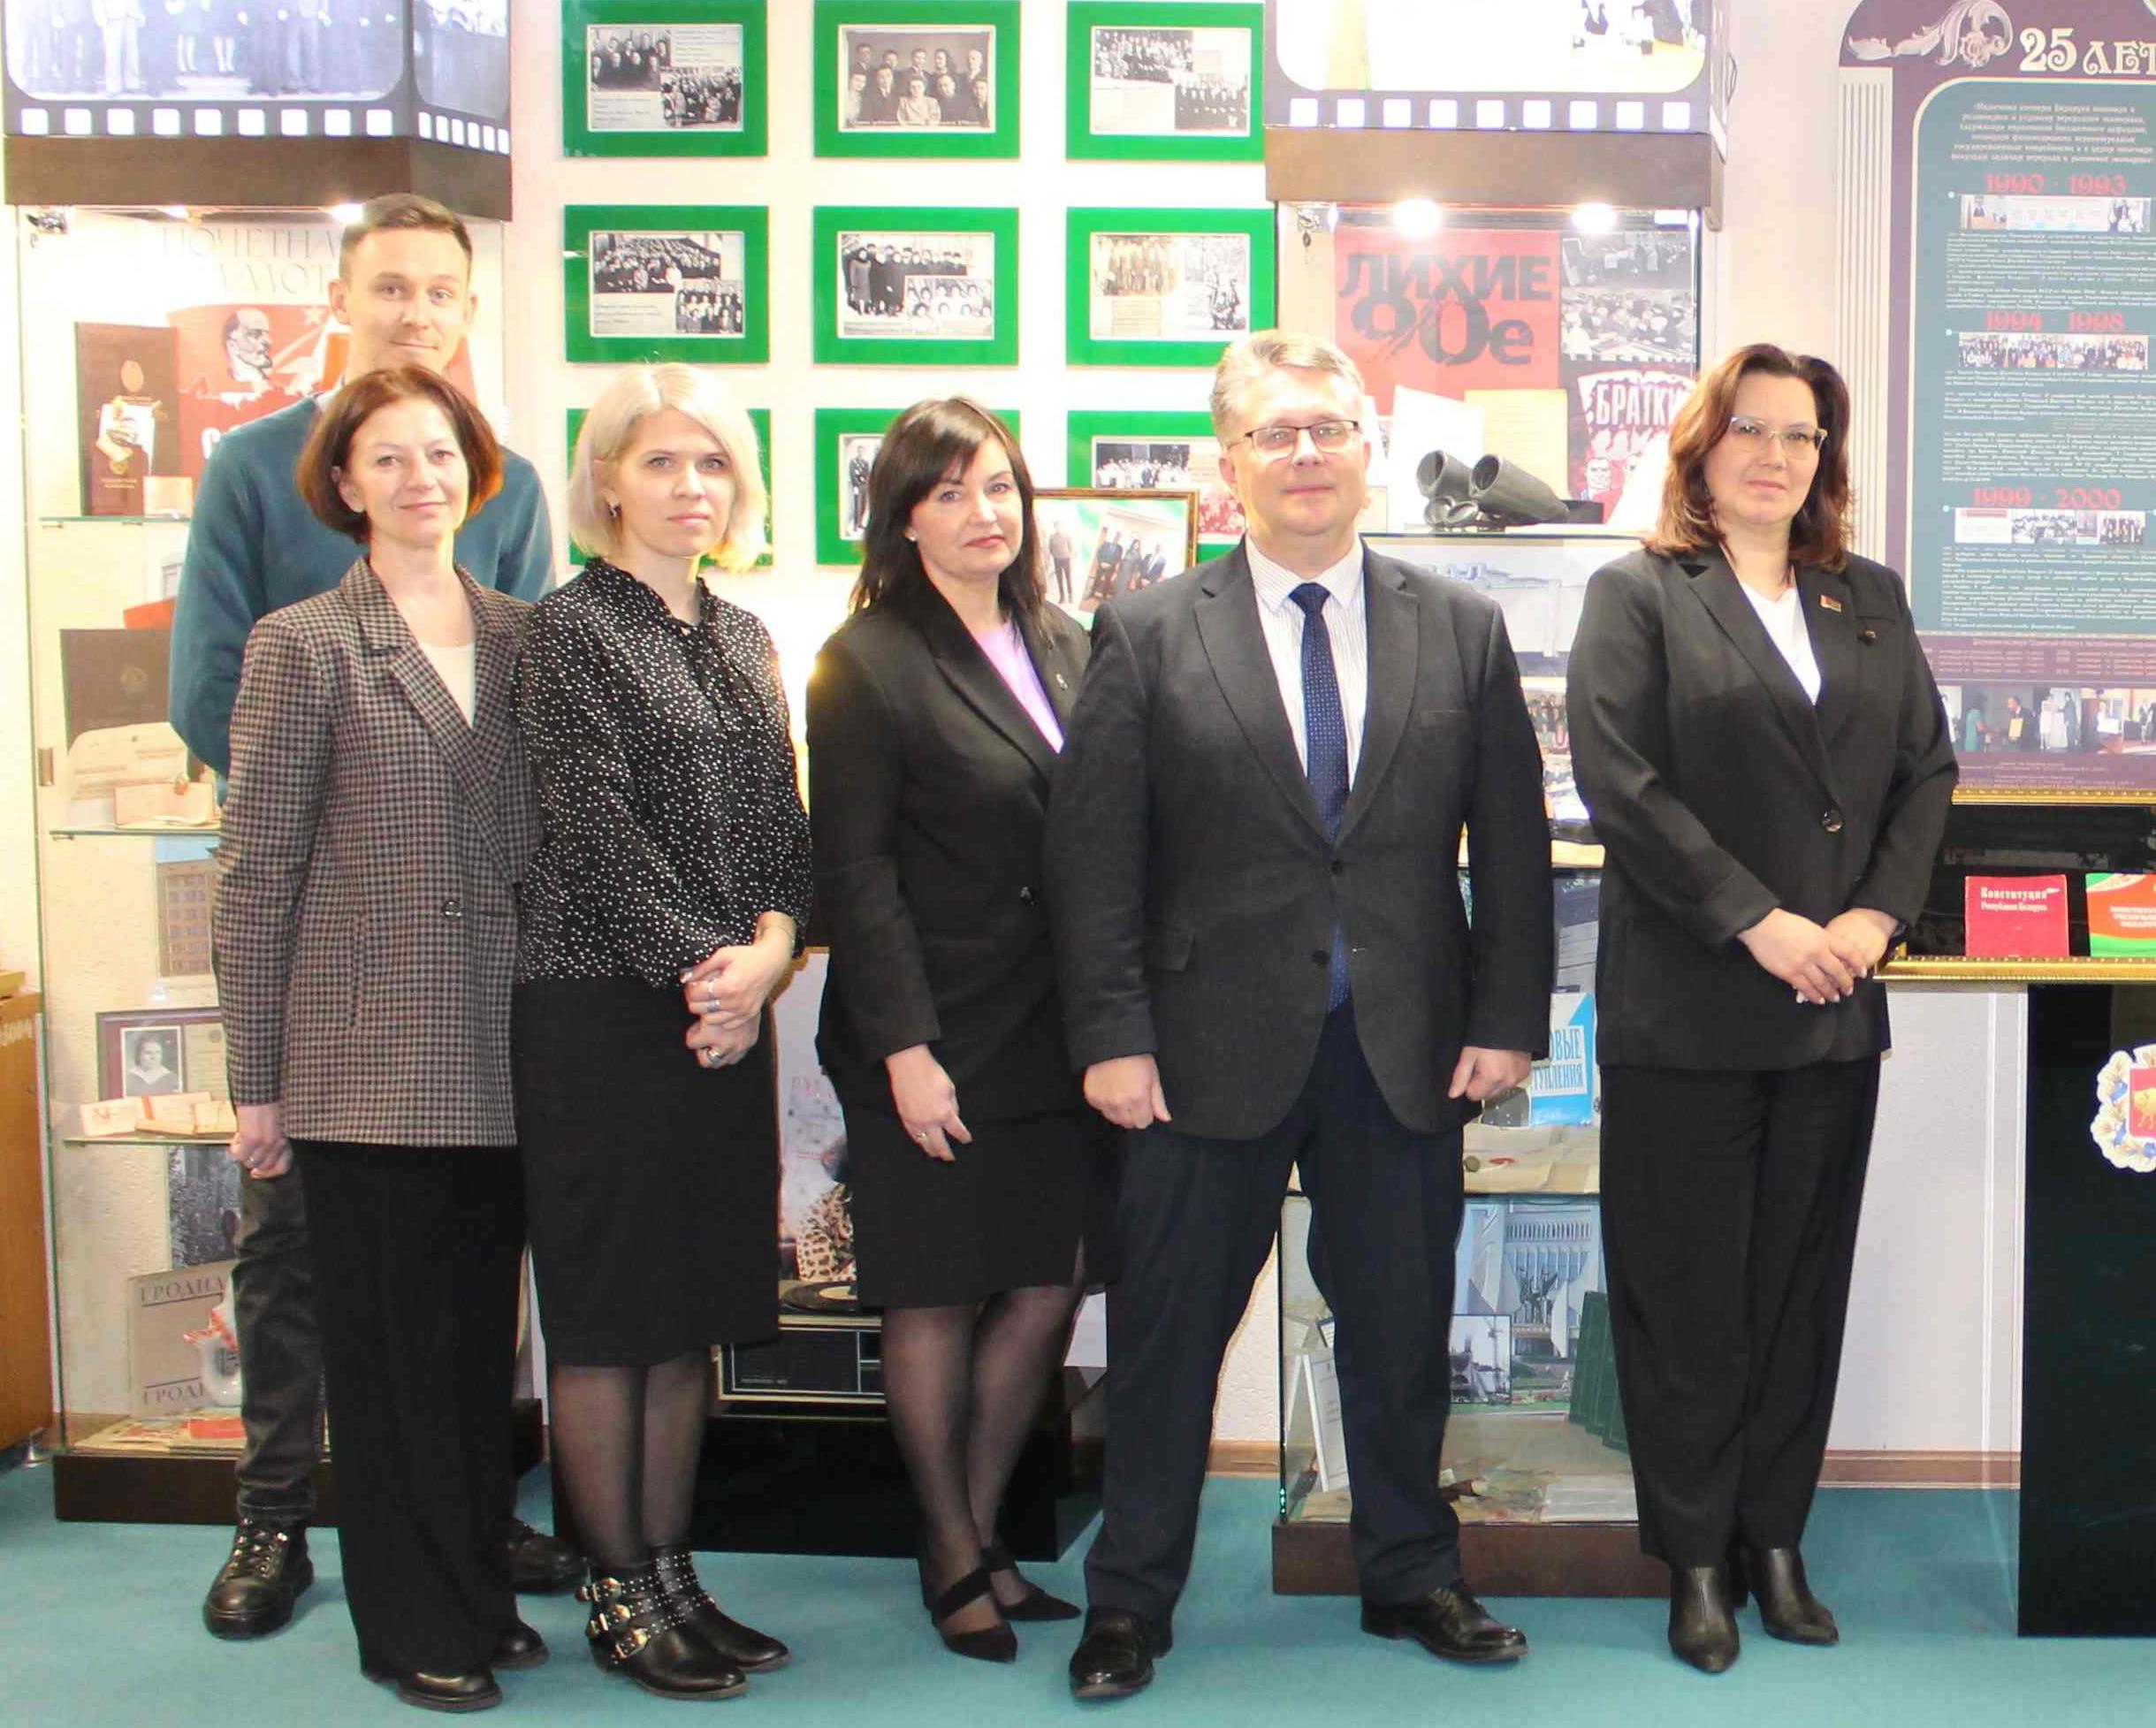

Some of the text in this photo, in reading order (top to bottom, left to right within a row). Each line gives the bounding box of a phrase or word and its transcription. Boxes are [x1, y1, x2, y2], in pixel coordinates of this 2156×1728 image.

[2020, 27, 2077, 72] 25
[1987, 173, 2045, 194] 1990
[2070, 174, 2127, 194] 1993
[1338, 253, 1552, 301] ЛИХИЕ
[1986, 310, 2043, 331] 1994
[2069, 311, 2126, 332] 1998
[2055, 488, 2121, 509] 2000
